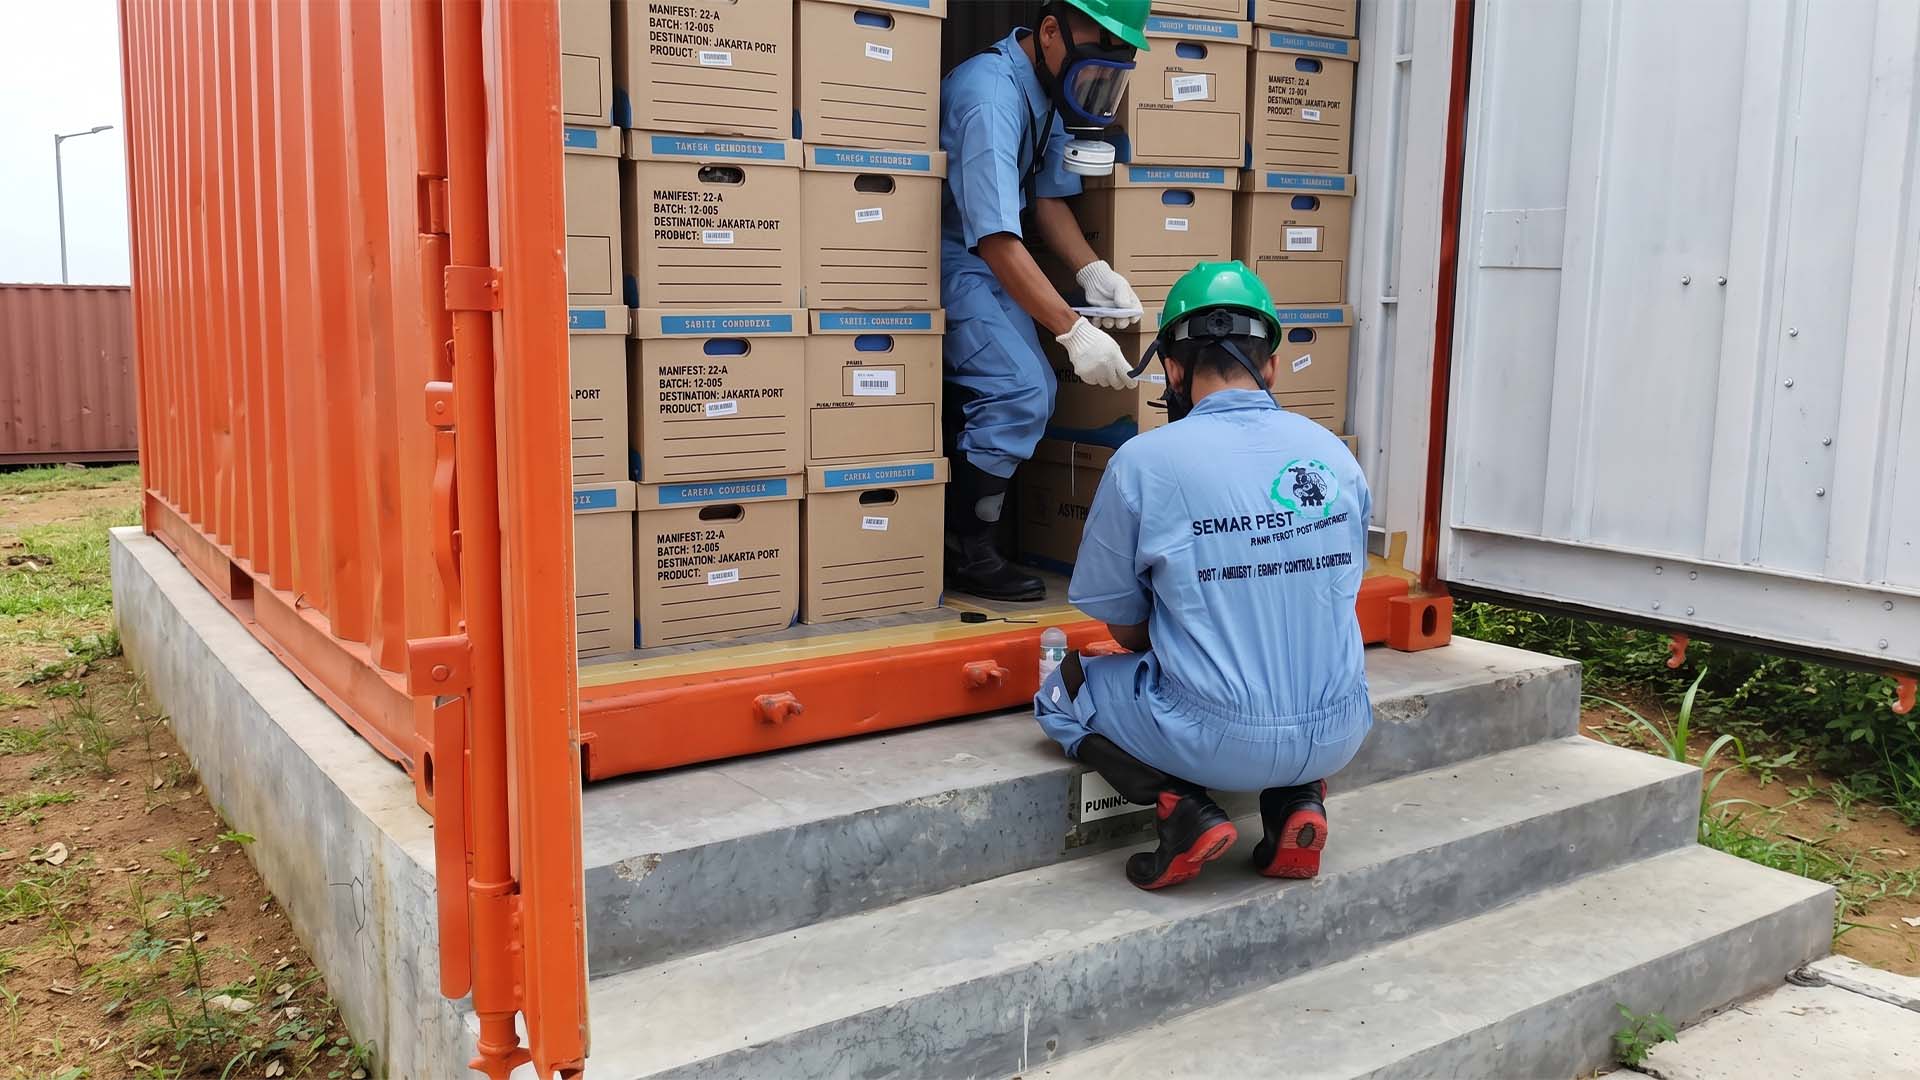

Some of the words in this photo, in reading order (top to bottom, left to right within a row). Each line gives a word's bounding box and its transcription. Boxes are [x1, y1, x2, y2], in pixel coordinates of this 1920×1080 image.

[649, 3, 698, 18] MANIFEST:
[699, 9, 720, 21] 22-A
[649, 17, 683, 30] BATCH:
[684, 21, 714, 33] 12-005
[649, 31, 712, 46] DESTINATION:
[713, 38, 753, 51] JAKARTA
[754, 42, 777, 54] PORT
[1304, 99, 1327, 108] JAKARTA
[1327, 101, 1341, 109] PORT
[653, 190, 701, 202] MANIFEST:
[702, 192, 724, 202] 22-A
[653, 203, 687, 214] BATCH:
[688, 205, 719, 215] 12-005
[654, 216, 715, 228] DESTINATION:
[716, 219, 756, 229] JAKARTA
[757, 220, 780, 230] PORT
[658, 365, 706, 376] MANIFEST:
[707, 365, 728, 375] 22-A
[659, 378, 692, 389] BATCH:
[694, 377, 723, 388] 12-005
[575, 389, 601, 400] PORT
[659, 390, 720, 401] DESTINATION:
[721, 388, 760, 400] JAKARTA
[761, 388, 784, 398] PORT
[659, 403, 705, 414] PRODUCT:
[1192, 515, 1253, 536] SEMAR
[1255, 511, 1295, 530] PEST
[1296, 523, 1314, 537] POST
[656, 531, 704, 545] MANIFEST:
[705, 529, 725, 540] 22-A
[657, 545, 689, 557] BATCH:
[691, 542, 720, 554] 12-005
[657, 555, 716, 569] DESTINATION:
[717, 551, 756, 564] JAKARTA
[757, 548, 780, 560] PORT
[657, 568, 701, 581] PRODUCT:
[1197, 568, 1217, 583] POST
[1284, 557, 1315, 575] CONTROL
